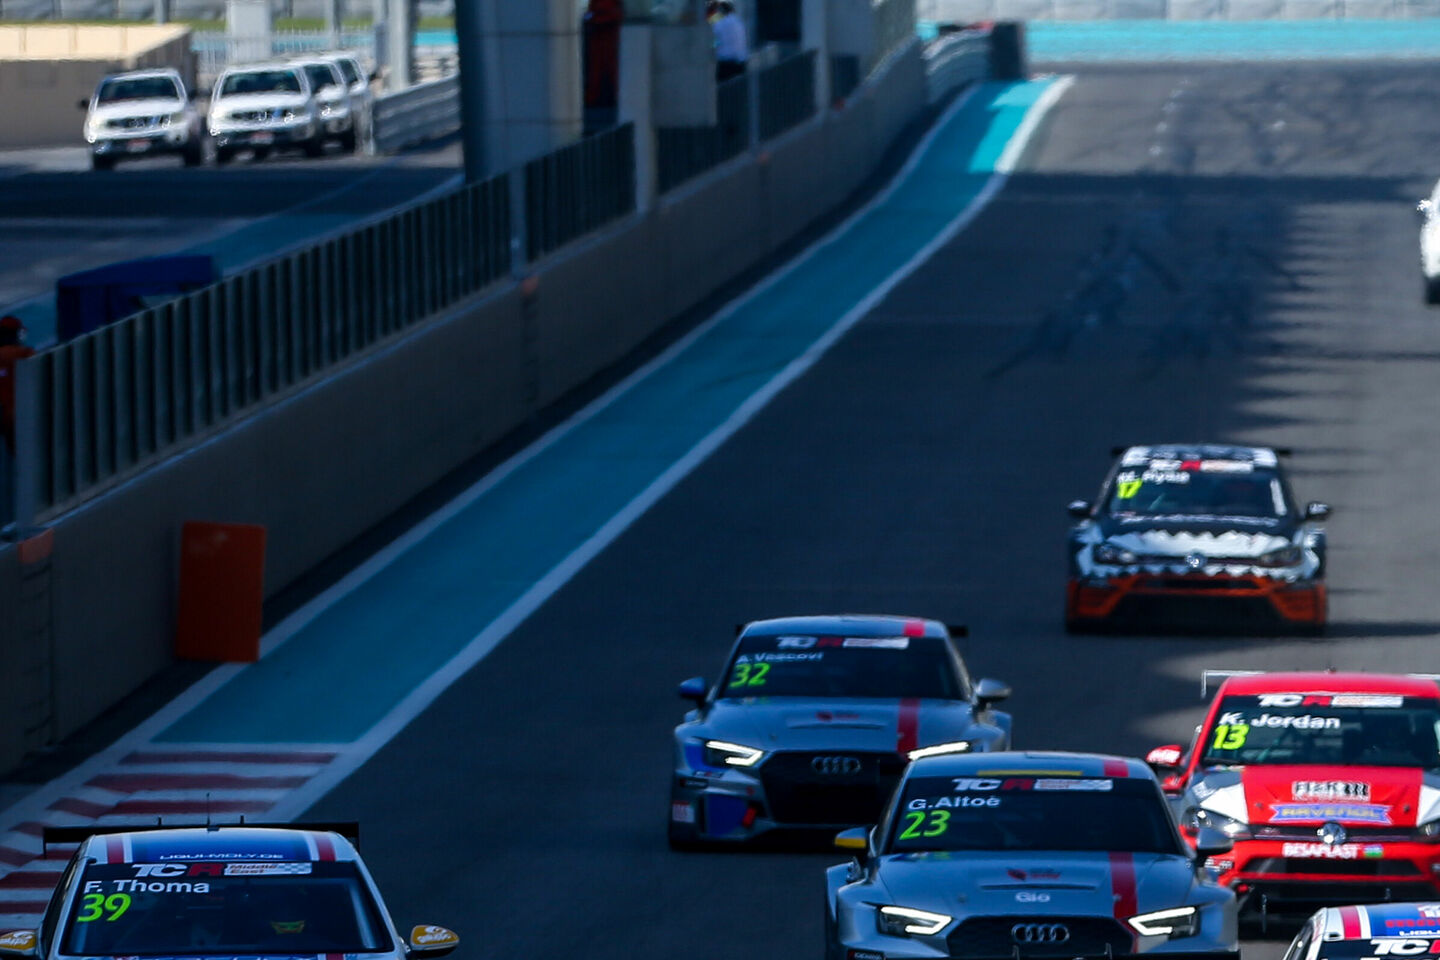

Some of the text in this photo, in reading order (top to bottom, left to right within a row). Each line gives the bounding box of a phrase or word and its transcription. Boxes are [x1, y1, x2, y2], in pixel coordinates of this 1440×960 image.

[730, 662, 770, 687] 32
[1252, 713, 1340, 729] Jordan
[1213, 724, 1249, 750] 13
[900, 809, 950, 840] 23
[132, 863, 225, 877] TCR
[83, 879, 209, 893] F. Thoma
[77, 893, 132, 922] 39
